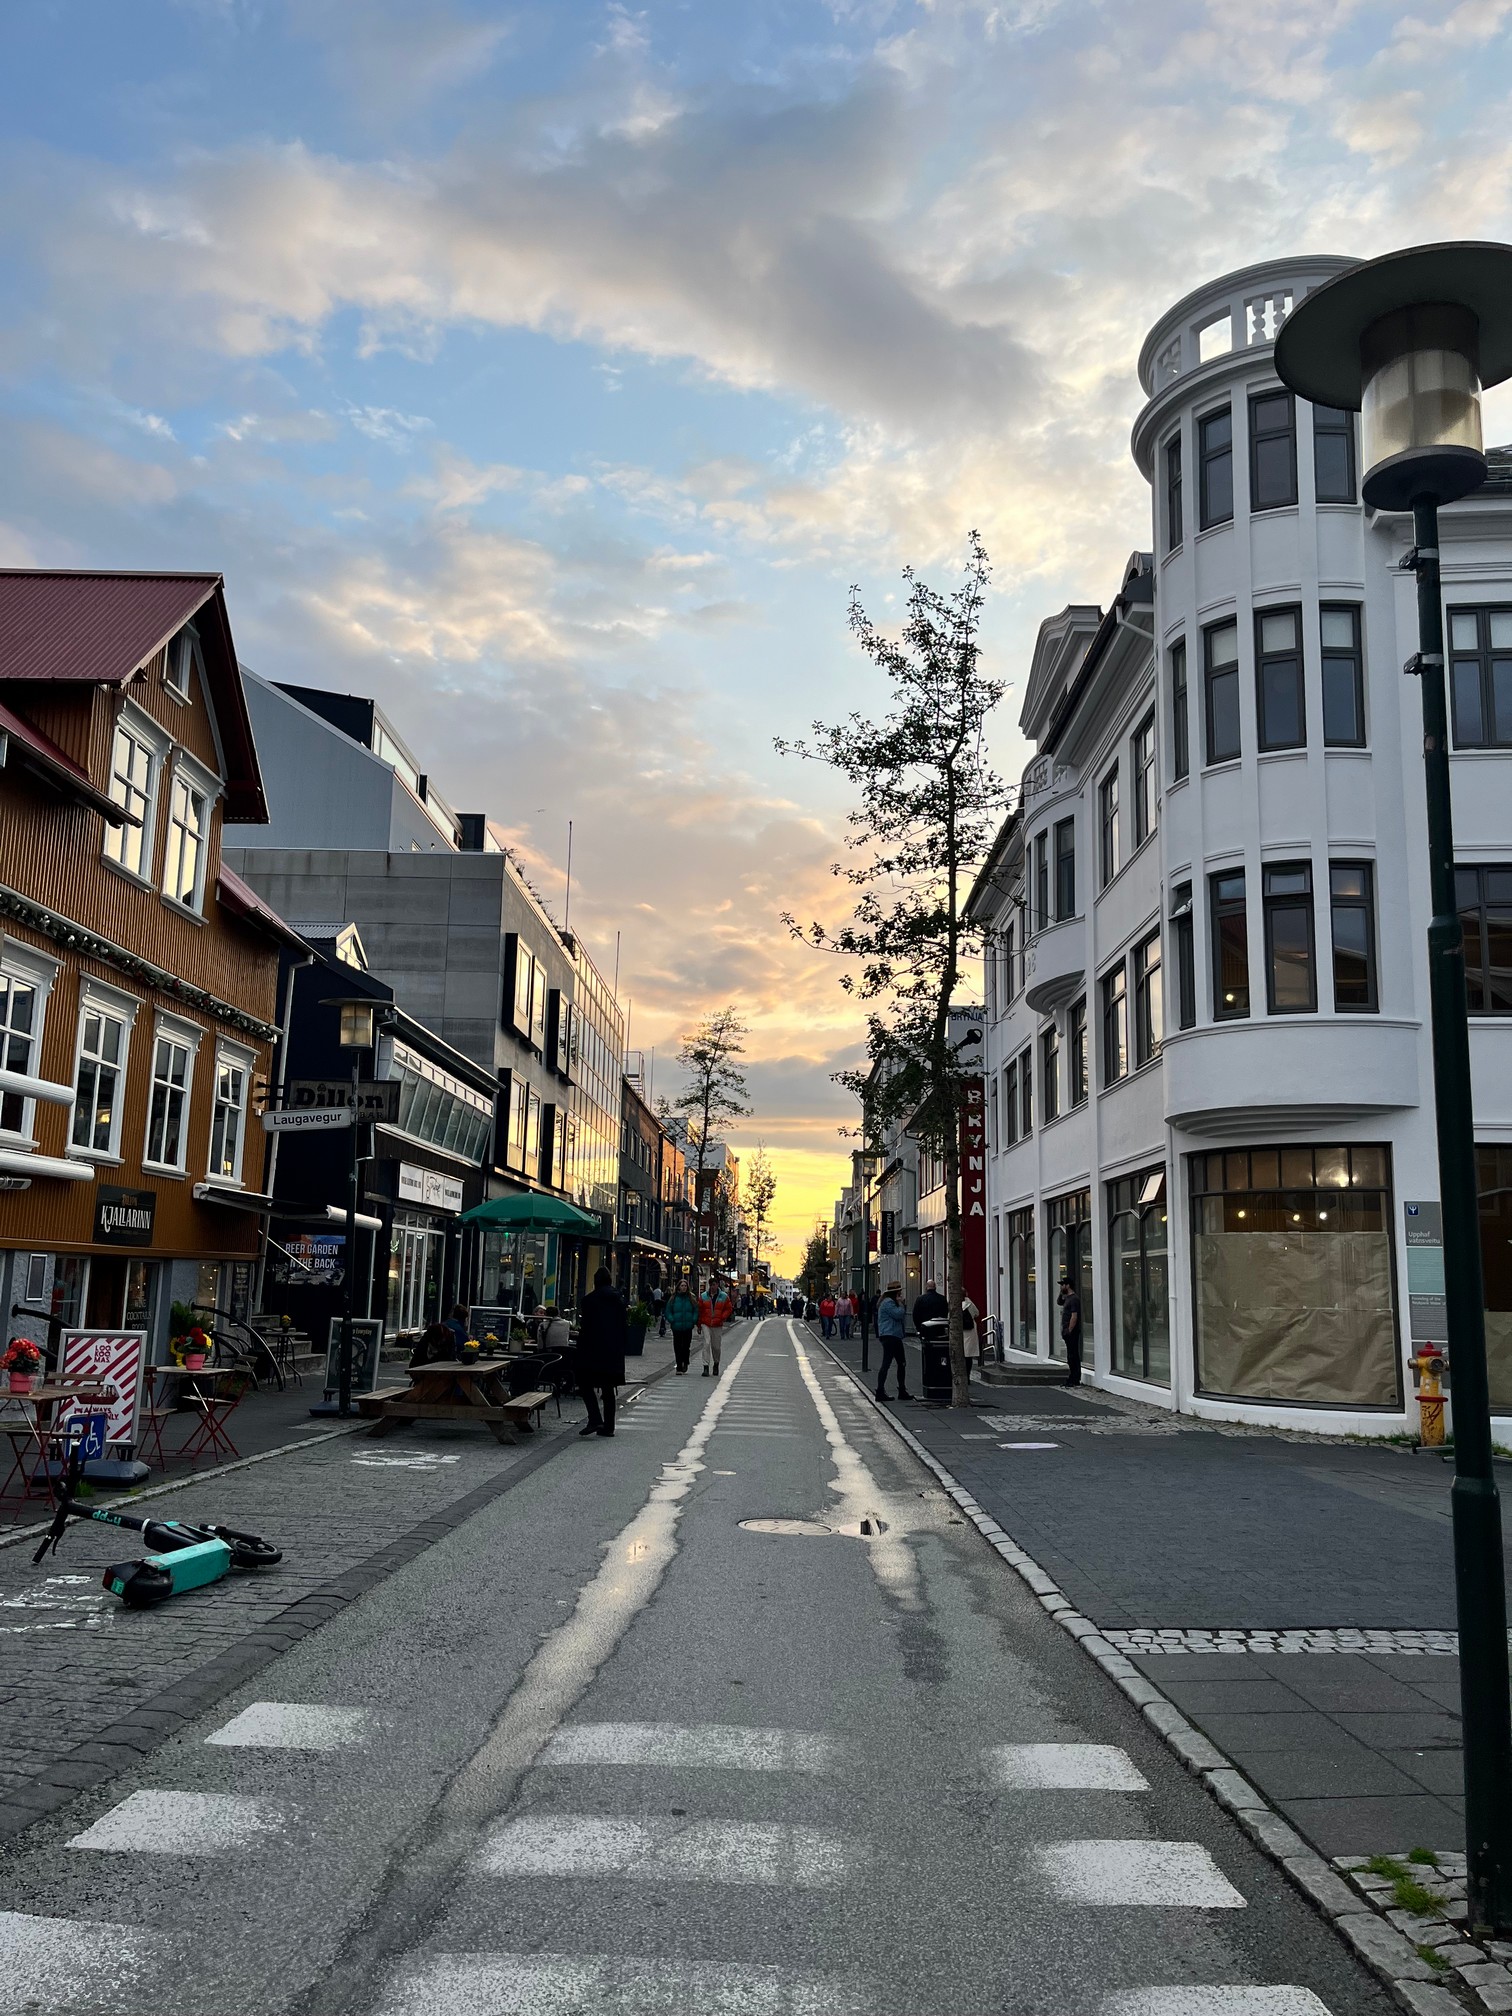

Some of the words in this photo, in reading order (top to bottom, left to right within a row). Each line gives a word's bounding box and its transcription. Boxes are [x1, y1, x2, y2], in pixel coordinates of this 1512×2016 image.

[295, 1083, 384, 1109] Dillon
[273, 1112, 342, 1126] Laugavegur
[967, 1089, 985, 1216] BRYNJA
[100, 1205, 152, 1233] KJALLARINN
[1408, 1231, 1430, 1239] Upphaf
[285, 1243, 306, 1254] BEER
[307, 1244, 339, 1255] GARDEN
[314, 1258, 336, 1269] BACK
